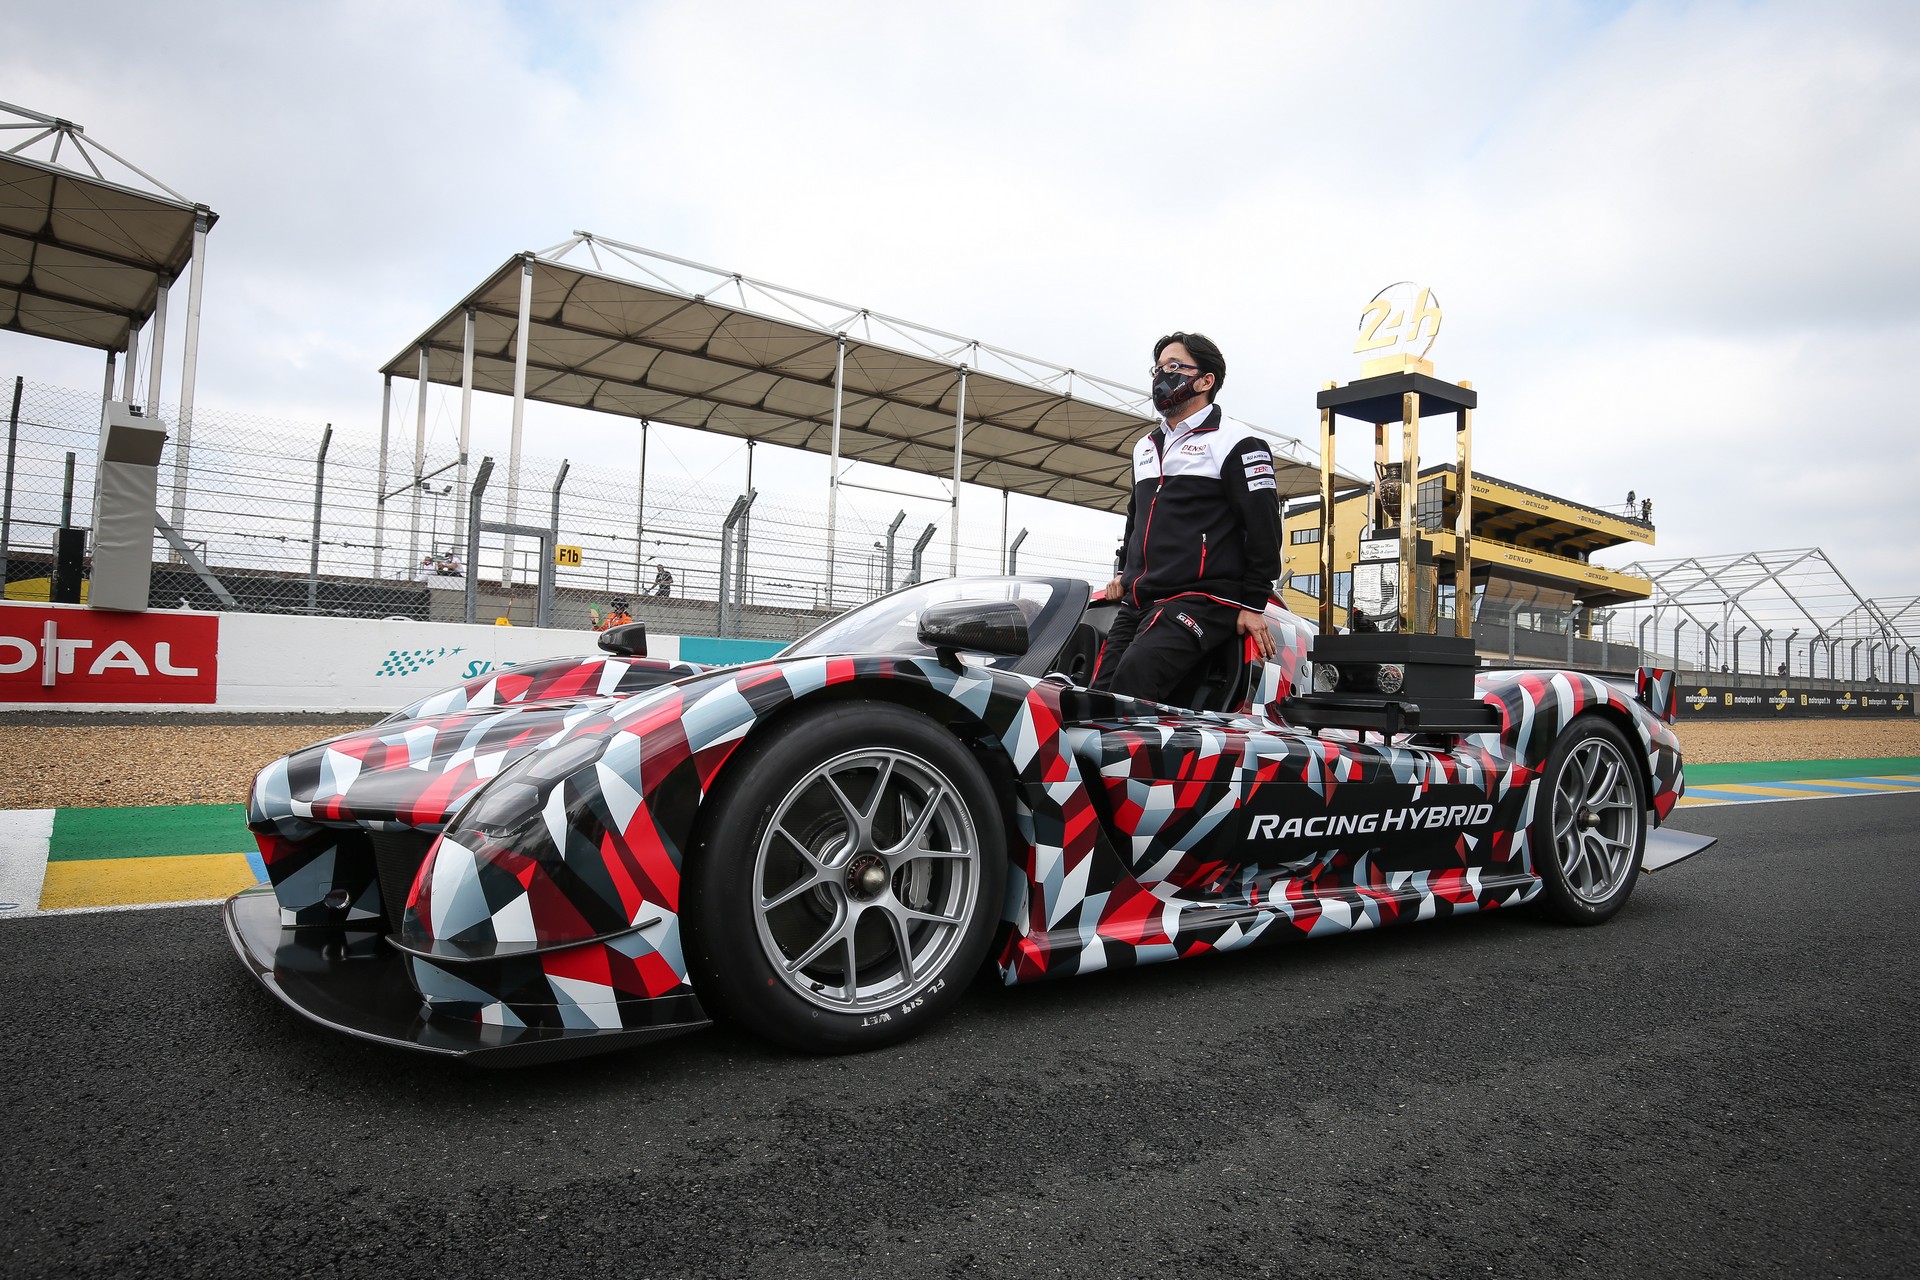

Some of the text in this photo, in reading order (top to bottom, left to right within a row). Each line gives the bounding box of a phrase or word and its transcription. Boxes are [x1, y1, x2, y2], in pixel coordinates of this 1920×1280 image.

[1525, 500, 1549, 511] DUNLOP
[1581, 515, 1602, 526] DUNLOP
[1630, 530, 1649, 539] DUNLOP
[560, 548, 579, 563] F1b
[1508, 554, 1533, 565] DUNLOP
[1588, 572, 1609, 581] DUNLOP
[1685, 694, 1717, 704] motorsport.com
[1768, 696, 1795, 704] motorsport.com
[1836, 698, 1858, 706] motorsport.com
[1381, 804, 1493, 832] HYBRID
[927, 978, 945, 994] FL
[861, 1012, 892, 1027] WET
